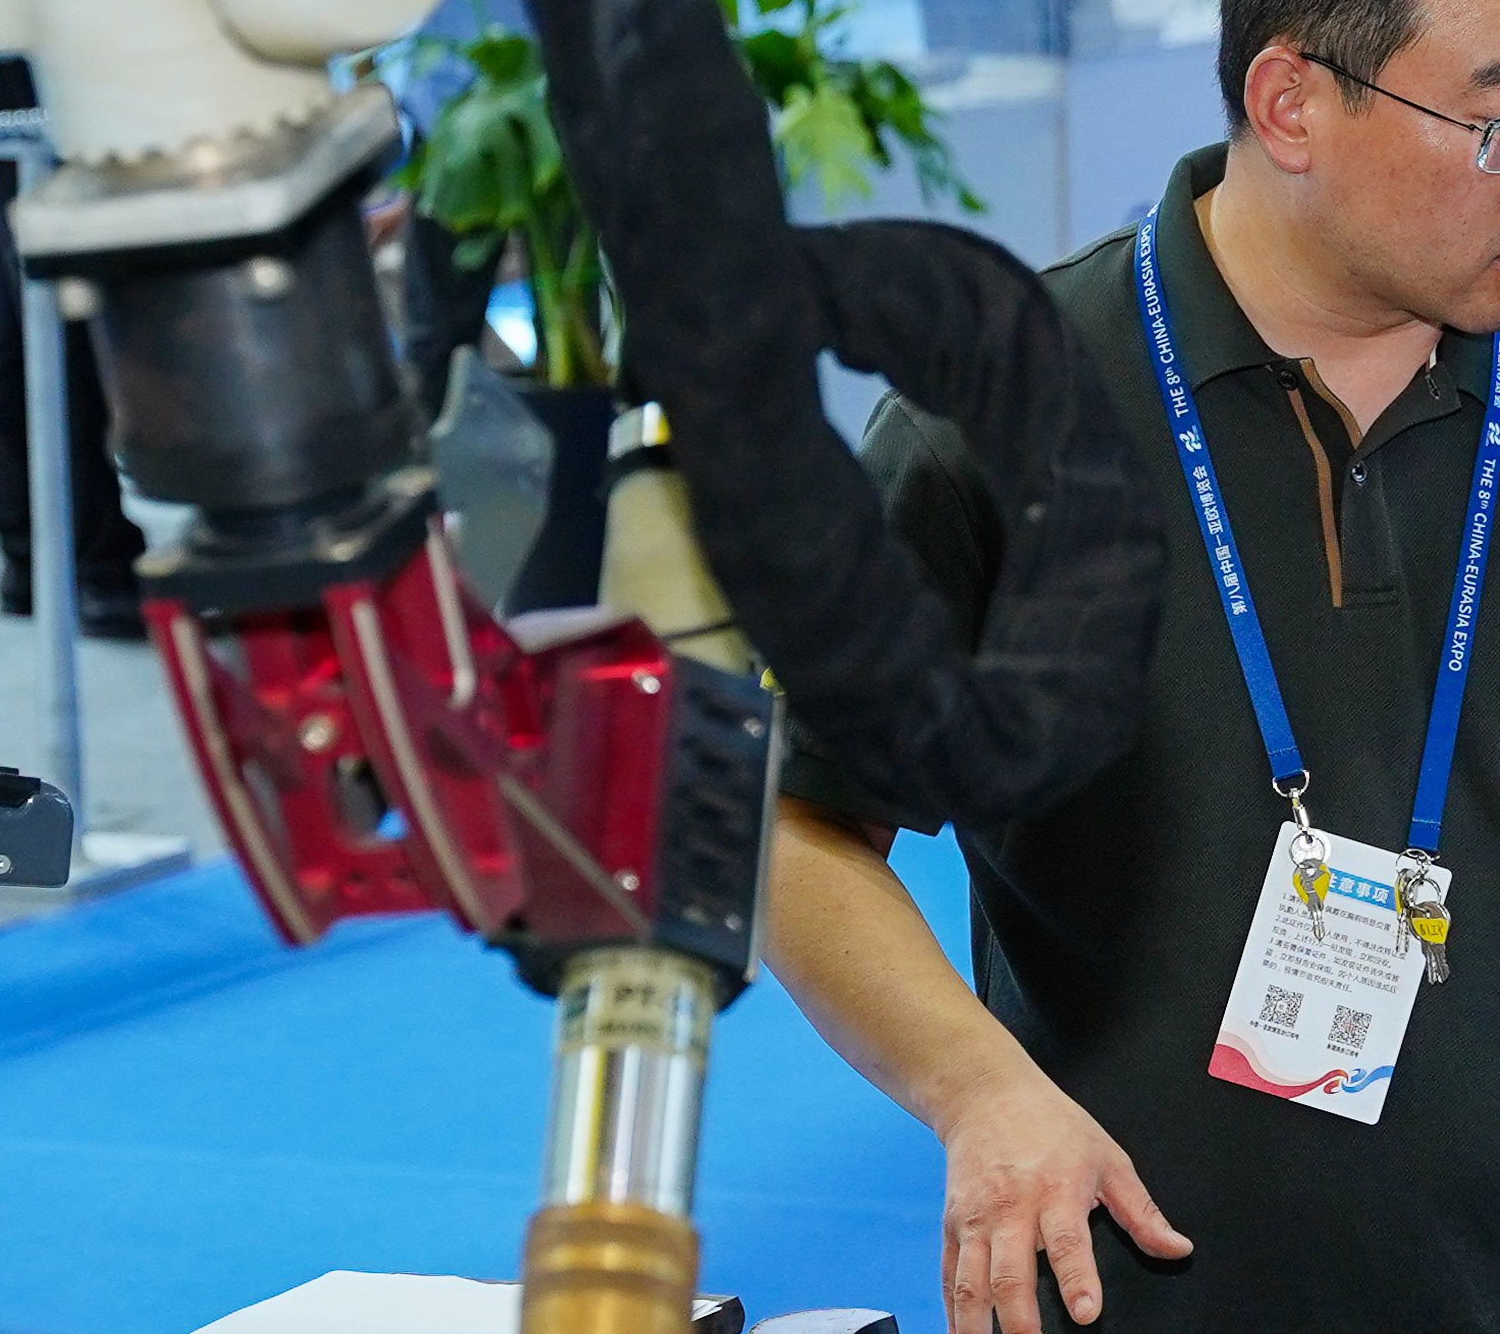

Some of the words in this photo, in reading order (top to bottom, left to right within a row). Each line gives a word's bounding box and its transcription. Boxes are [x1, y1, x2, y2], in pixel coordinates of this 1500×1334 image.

[1139, 224, 1151, 259] EXPO
[1142, 256, 1174, 363] CHINA-EURASIA
[1165, 368, 1180, 384] 8th
[1170, 387, 1188, 417] THE
[1481, 460, 1495, 487] THE
[1479, 491, 1490, 509] 8th
[1457, 513, 1487, 627] CHINA-EURASIA
[1449, 631, 1467, 671] EXPO
